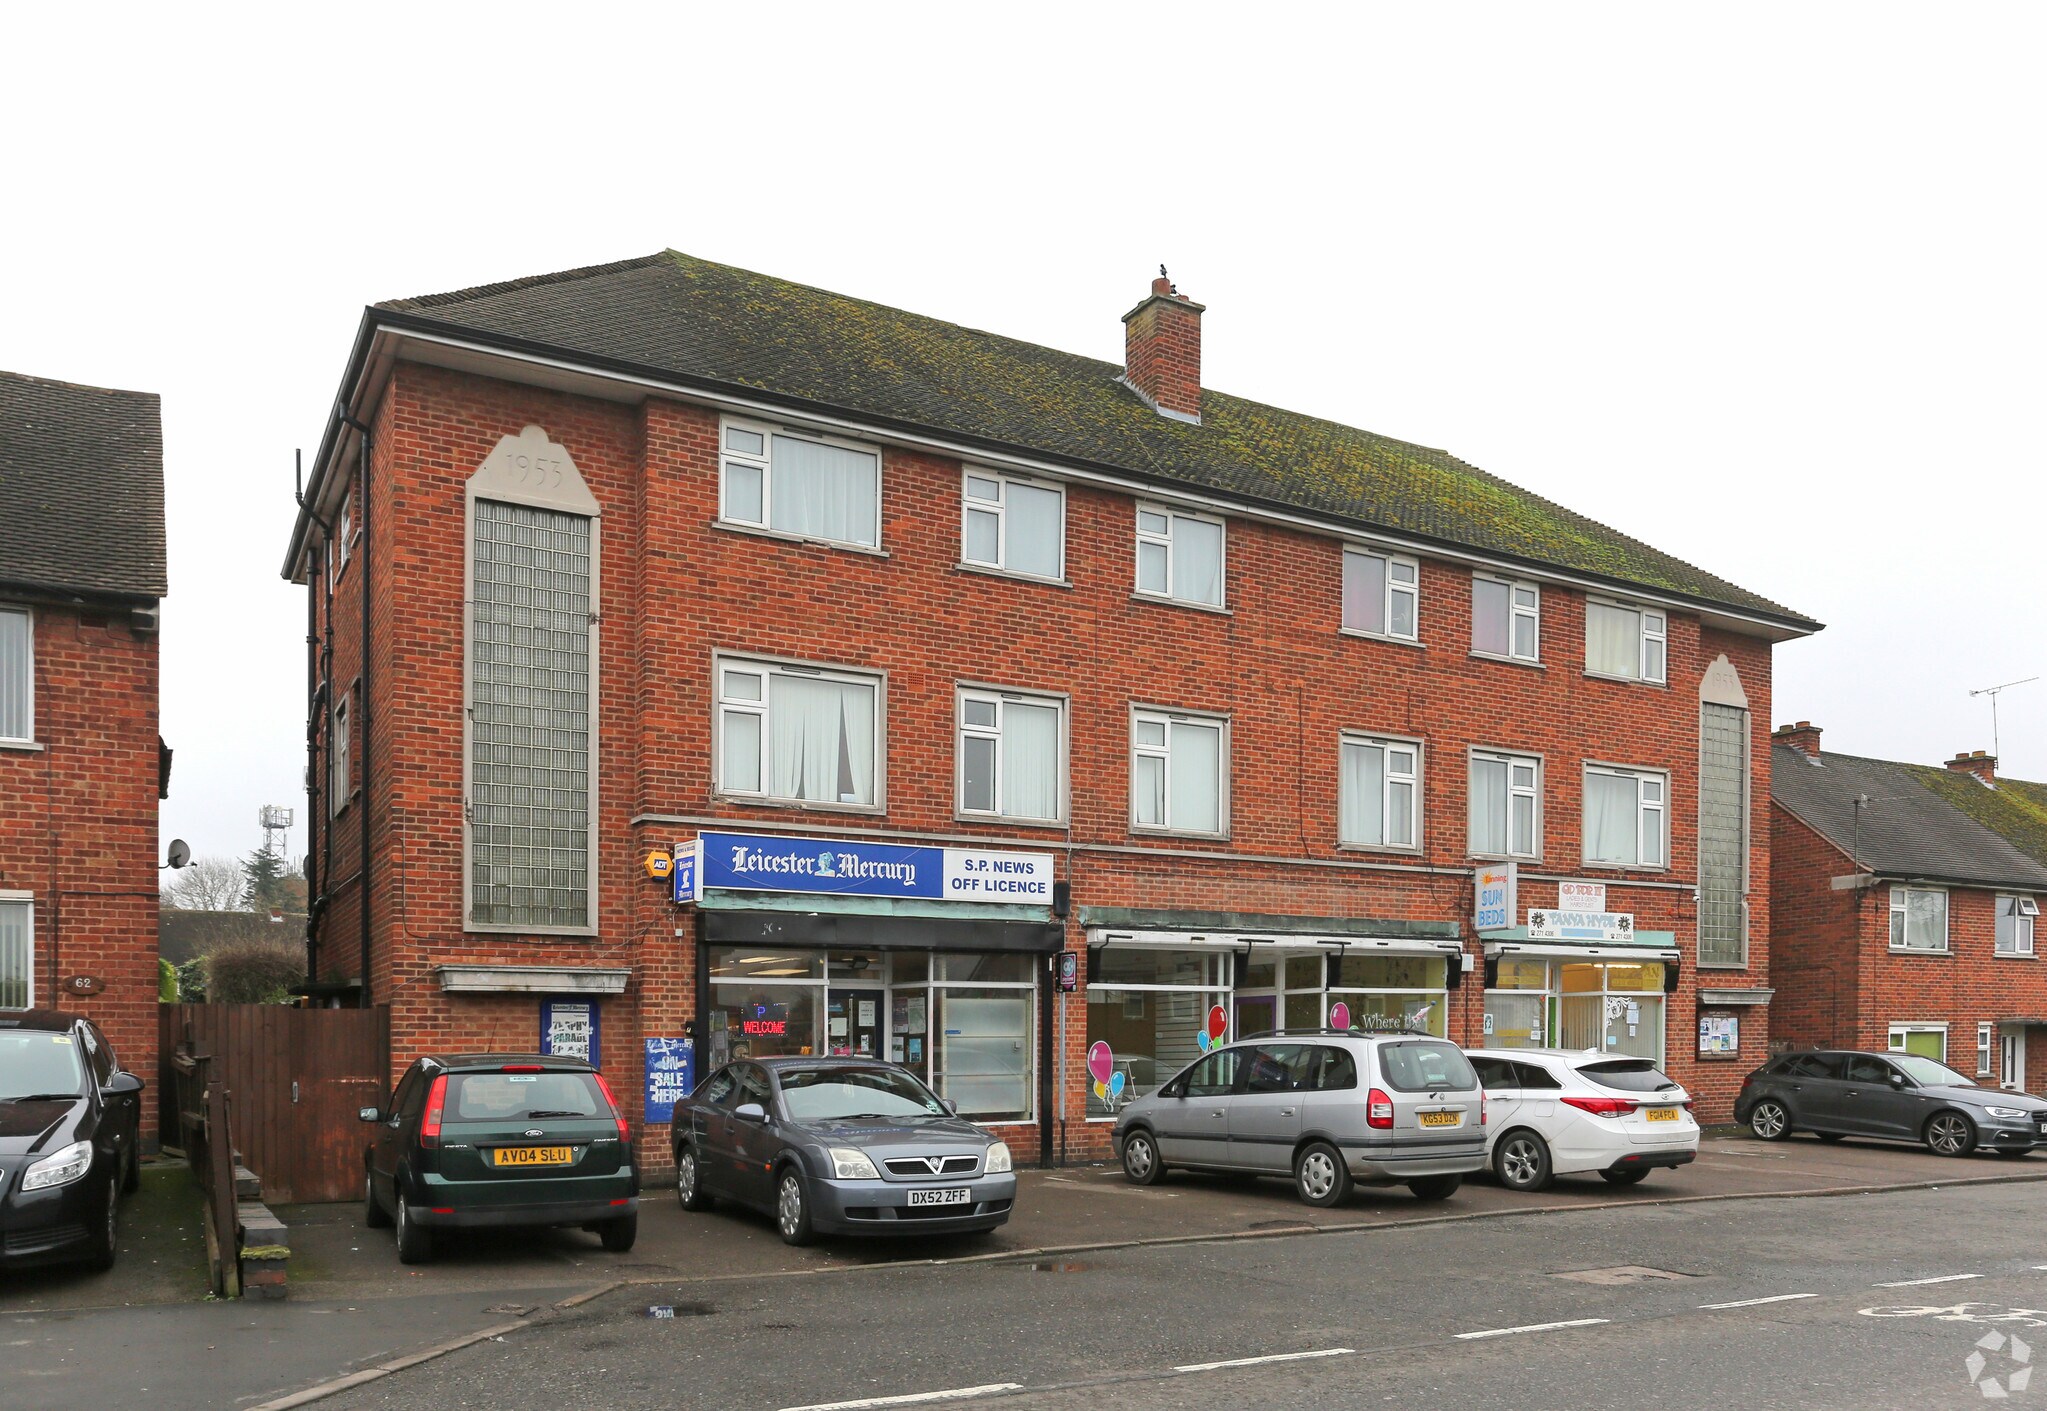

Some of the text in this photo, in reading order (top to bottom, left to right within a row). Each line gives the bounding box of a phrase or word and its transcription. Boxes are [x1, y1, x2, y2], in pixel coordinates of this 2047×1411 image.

[506, 454, 562, 489] 1953
[654, 861, 667, 869] ADT
[732, 846, 916, 886] Leicester Mercury
[965, 859, 1034, 874] S.P. NEWS
[952, 878, 1046, 893] OFF LICENCE
[1481, 889, 1503, 907] SUN
[1478, 908, 1506, 926] BEDS
[1548, 912, 1585, 927] TANYA
[75, 978, 91, 988] 62
[757, 1006, 766, 1018] P
[743, 1021, 786, 1034] WELCOME
[1362, 1013, 1401, 1029] Where
[662, 1055, 679, 1070] ON
[655, 1072, 683, 1087] SALE
[1423, 1113, 1458, 1123] KG53 DZN
[501, 1149, 566, 1163] AV04 SLU
[912, 1190, 966, 1204] DX52 ZFF
